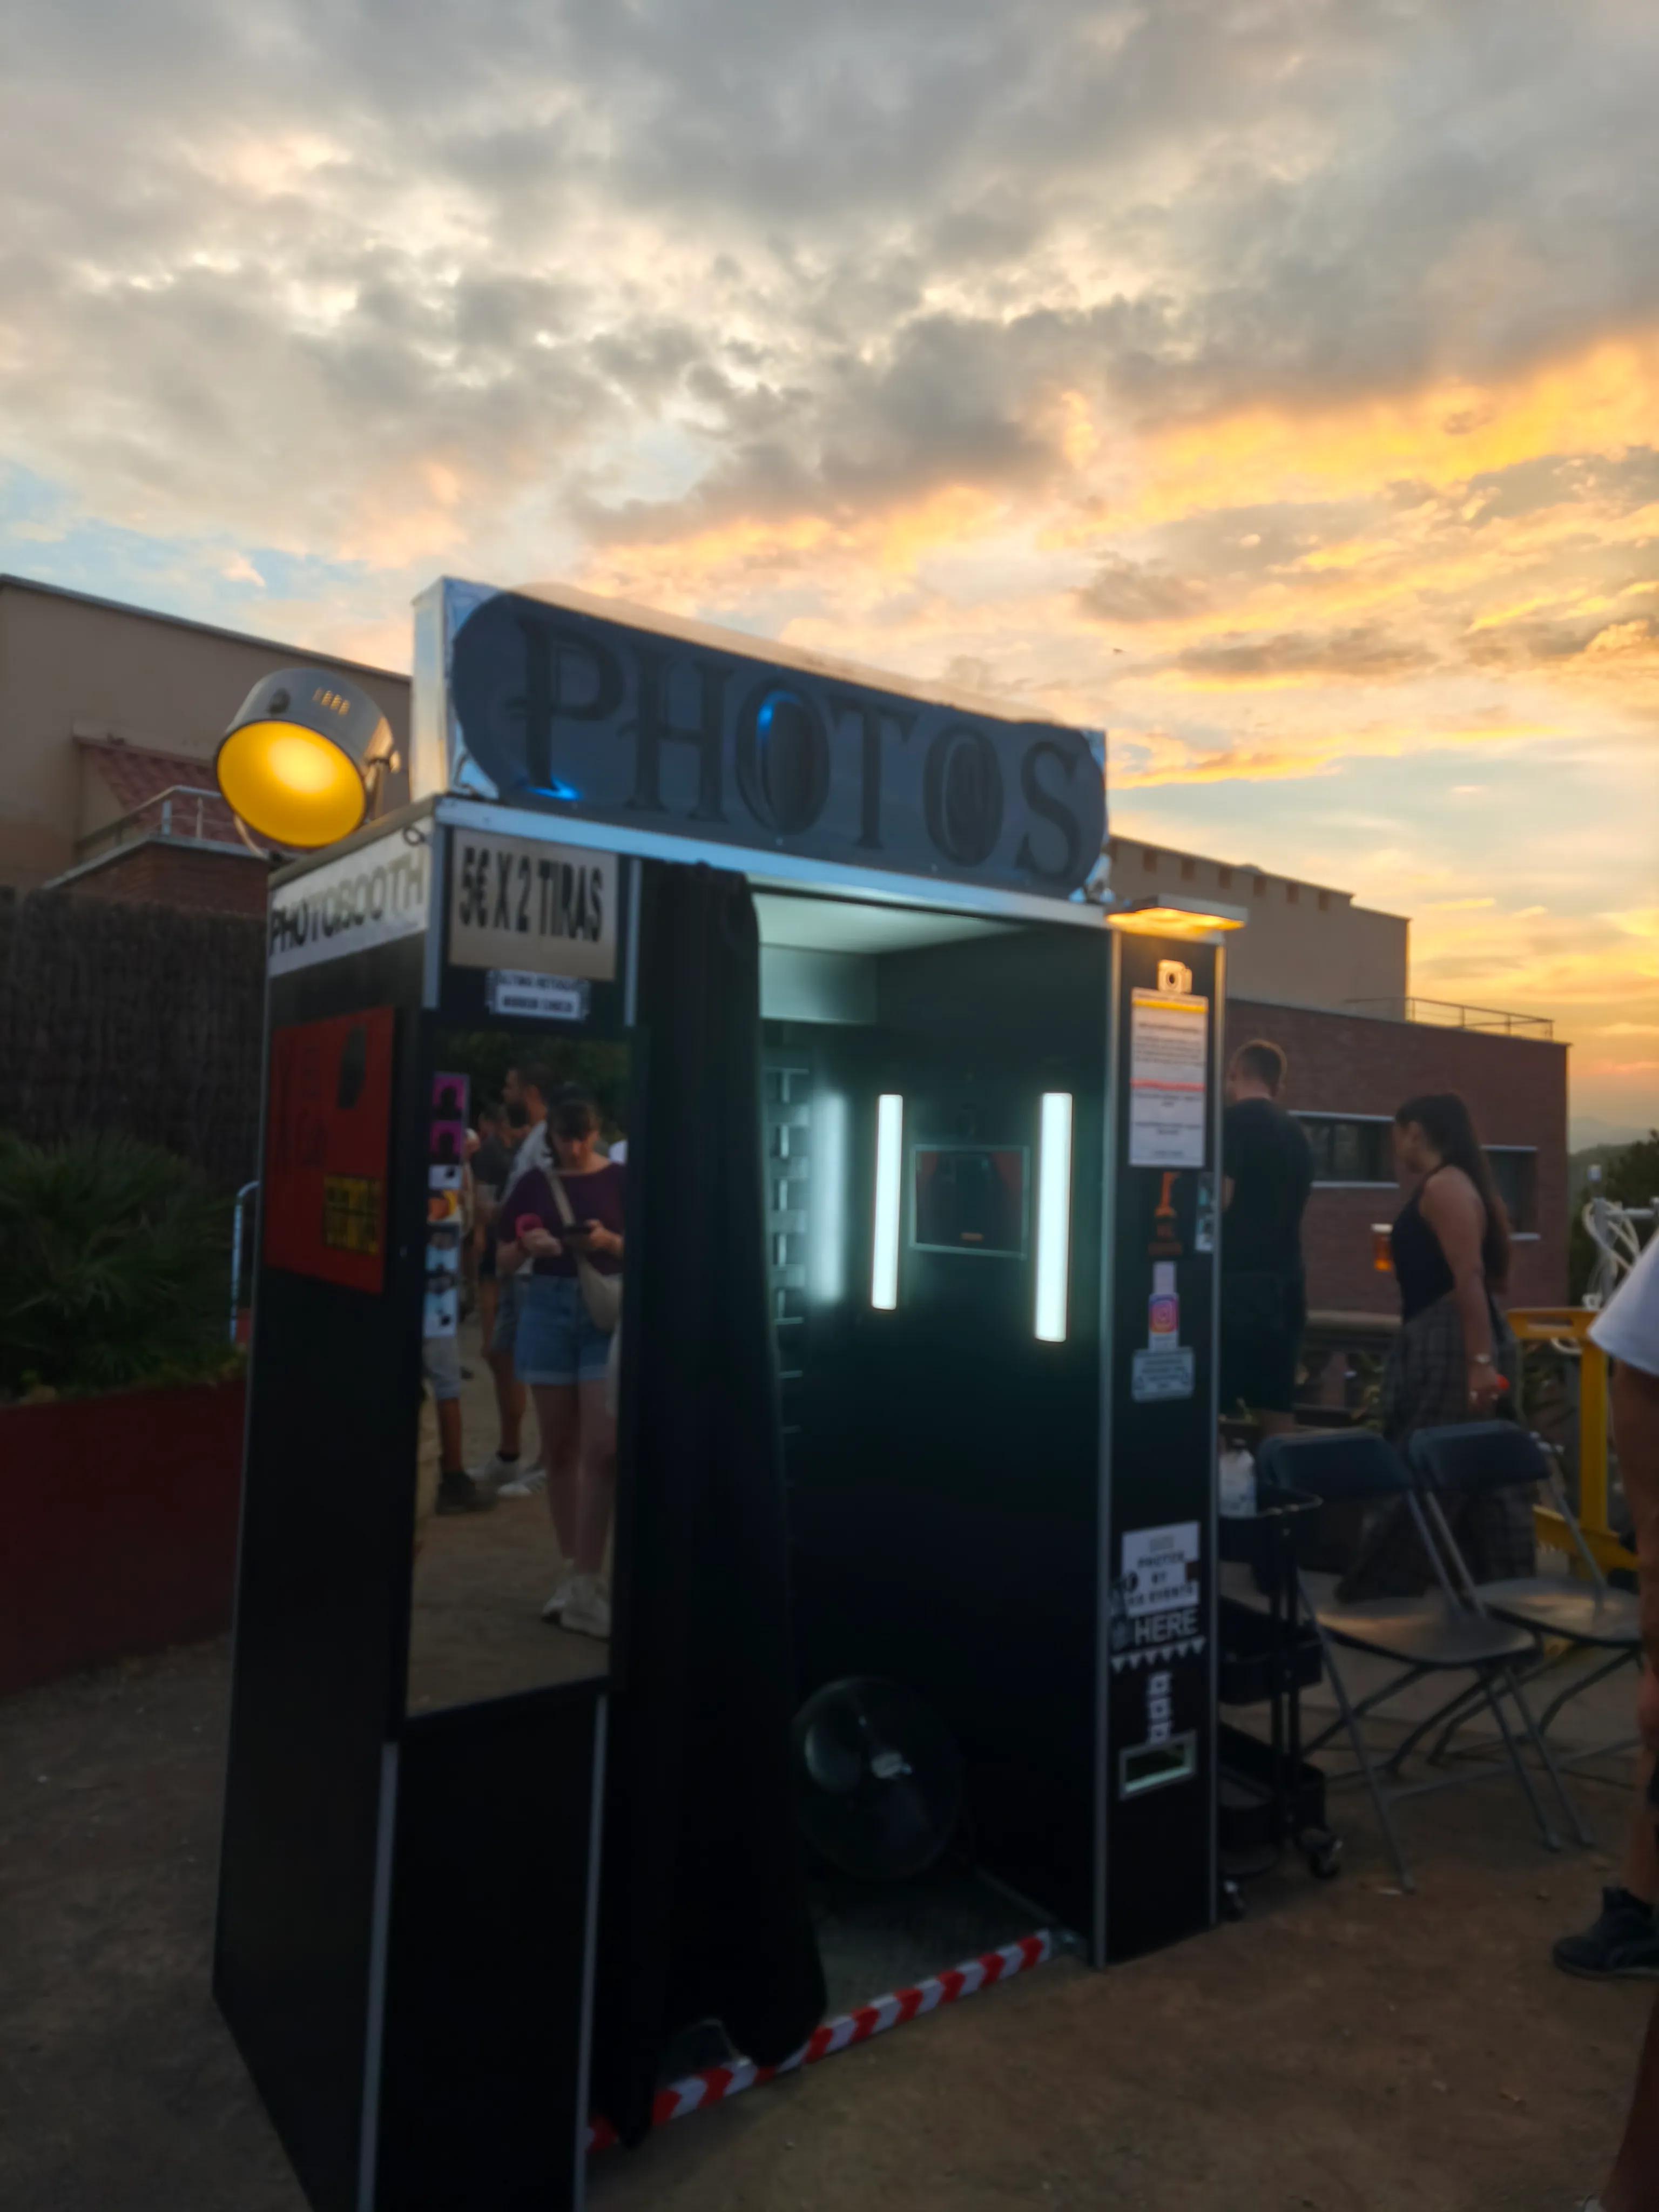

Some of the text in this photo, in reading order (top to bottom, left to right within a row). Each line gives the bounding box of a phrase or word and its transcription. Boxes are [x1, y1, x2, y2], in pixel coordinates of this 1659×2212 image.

[505, 613, 1081, 884] PHOTOS
[269, 847, 423, 957] PHOTOBOOTH
[460, 845, 603, 942] 5€ X 2 TIRAS
[1135, 1608, 1197, 1645] HERE
